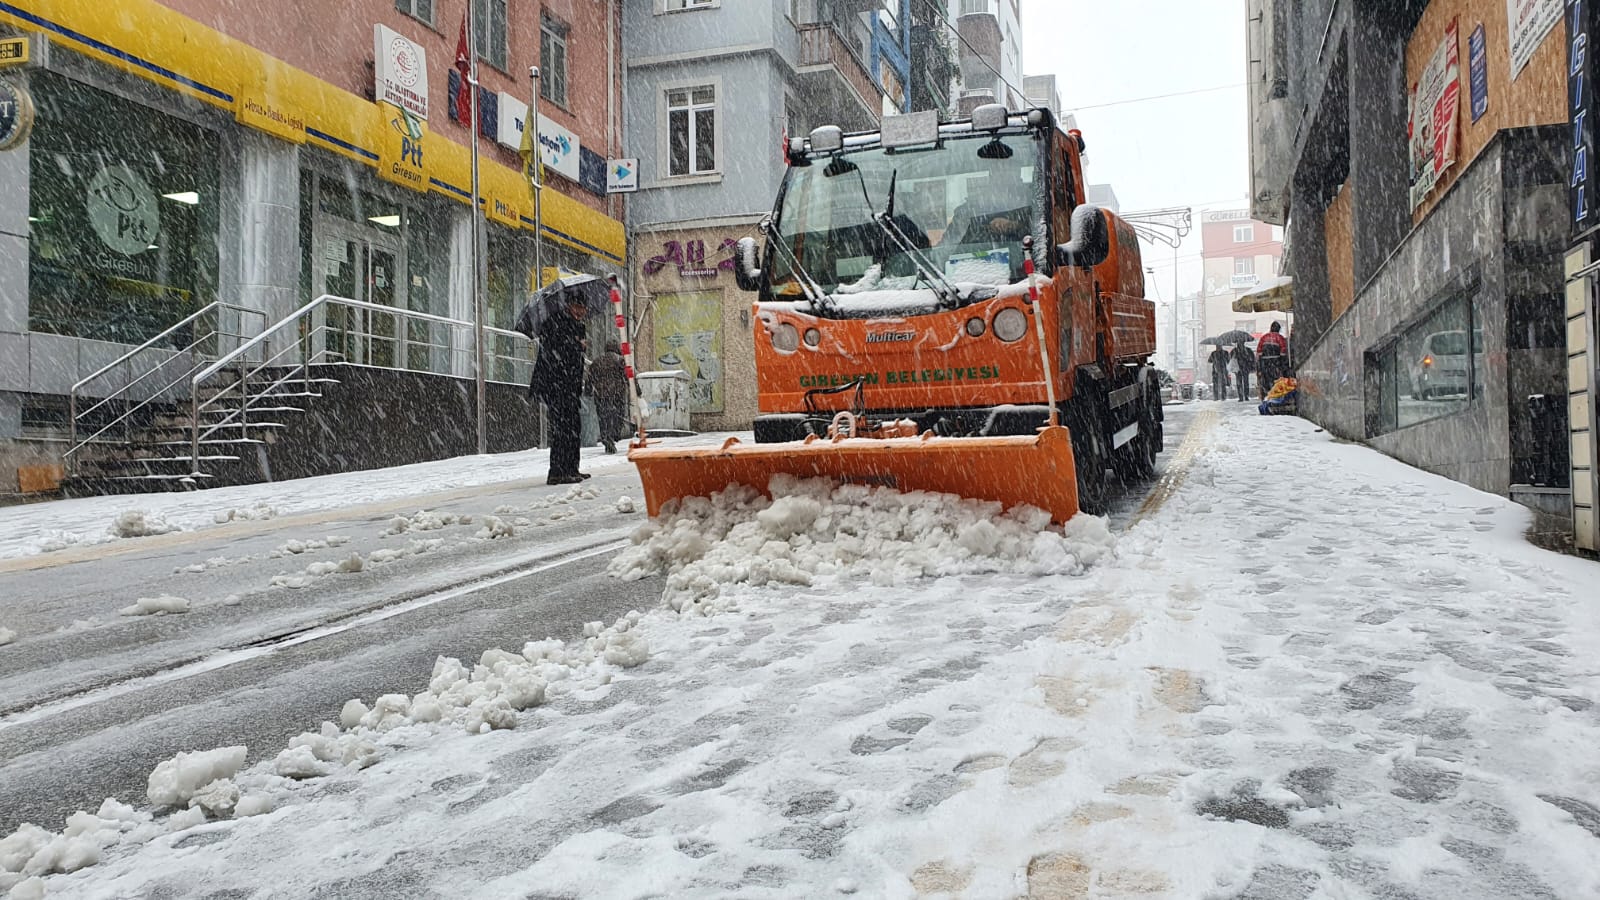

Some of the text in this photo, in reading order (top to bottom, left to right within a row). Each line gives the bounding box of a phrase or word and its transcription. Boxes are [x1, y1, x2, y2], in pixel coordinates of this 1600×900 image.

[1567, 0, 1587, 222] IGITAL
[402, 135, 423, 169] Ptt
[392, 161, 423, 184] Giresun
[118, 212, 149, 244] Ptt
[96, 252, 151, 278] Giresun
[865, 331, 916, 343] Multicar
